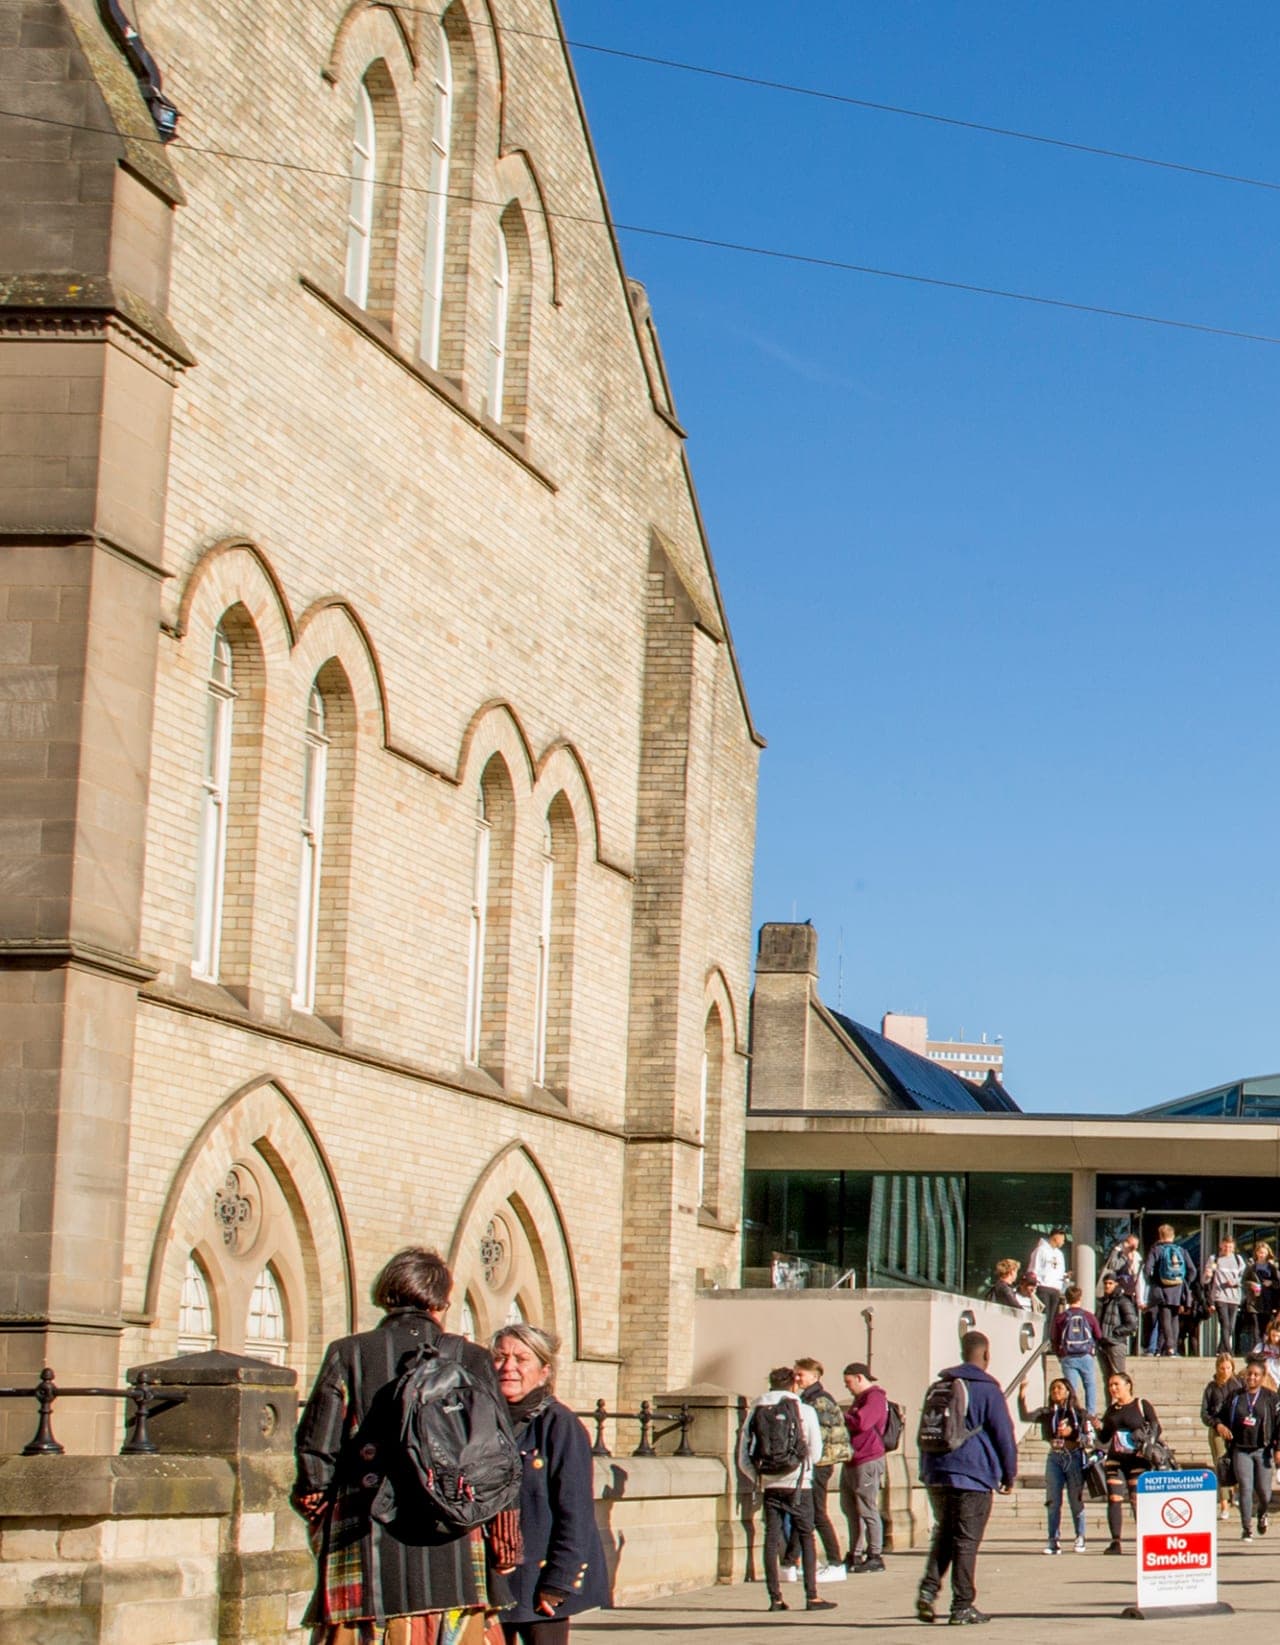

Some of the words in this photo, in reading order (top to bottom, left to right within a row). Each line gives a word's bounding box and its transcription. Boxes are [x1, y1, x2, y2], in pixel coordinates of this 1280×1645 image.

[1144, 1475, 1203, 1485] NOTTINGHAM
[1166, 1536, 1188, 1550] No
[1146, 1551, 1208, 1566] Smoking
